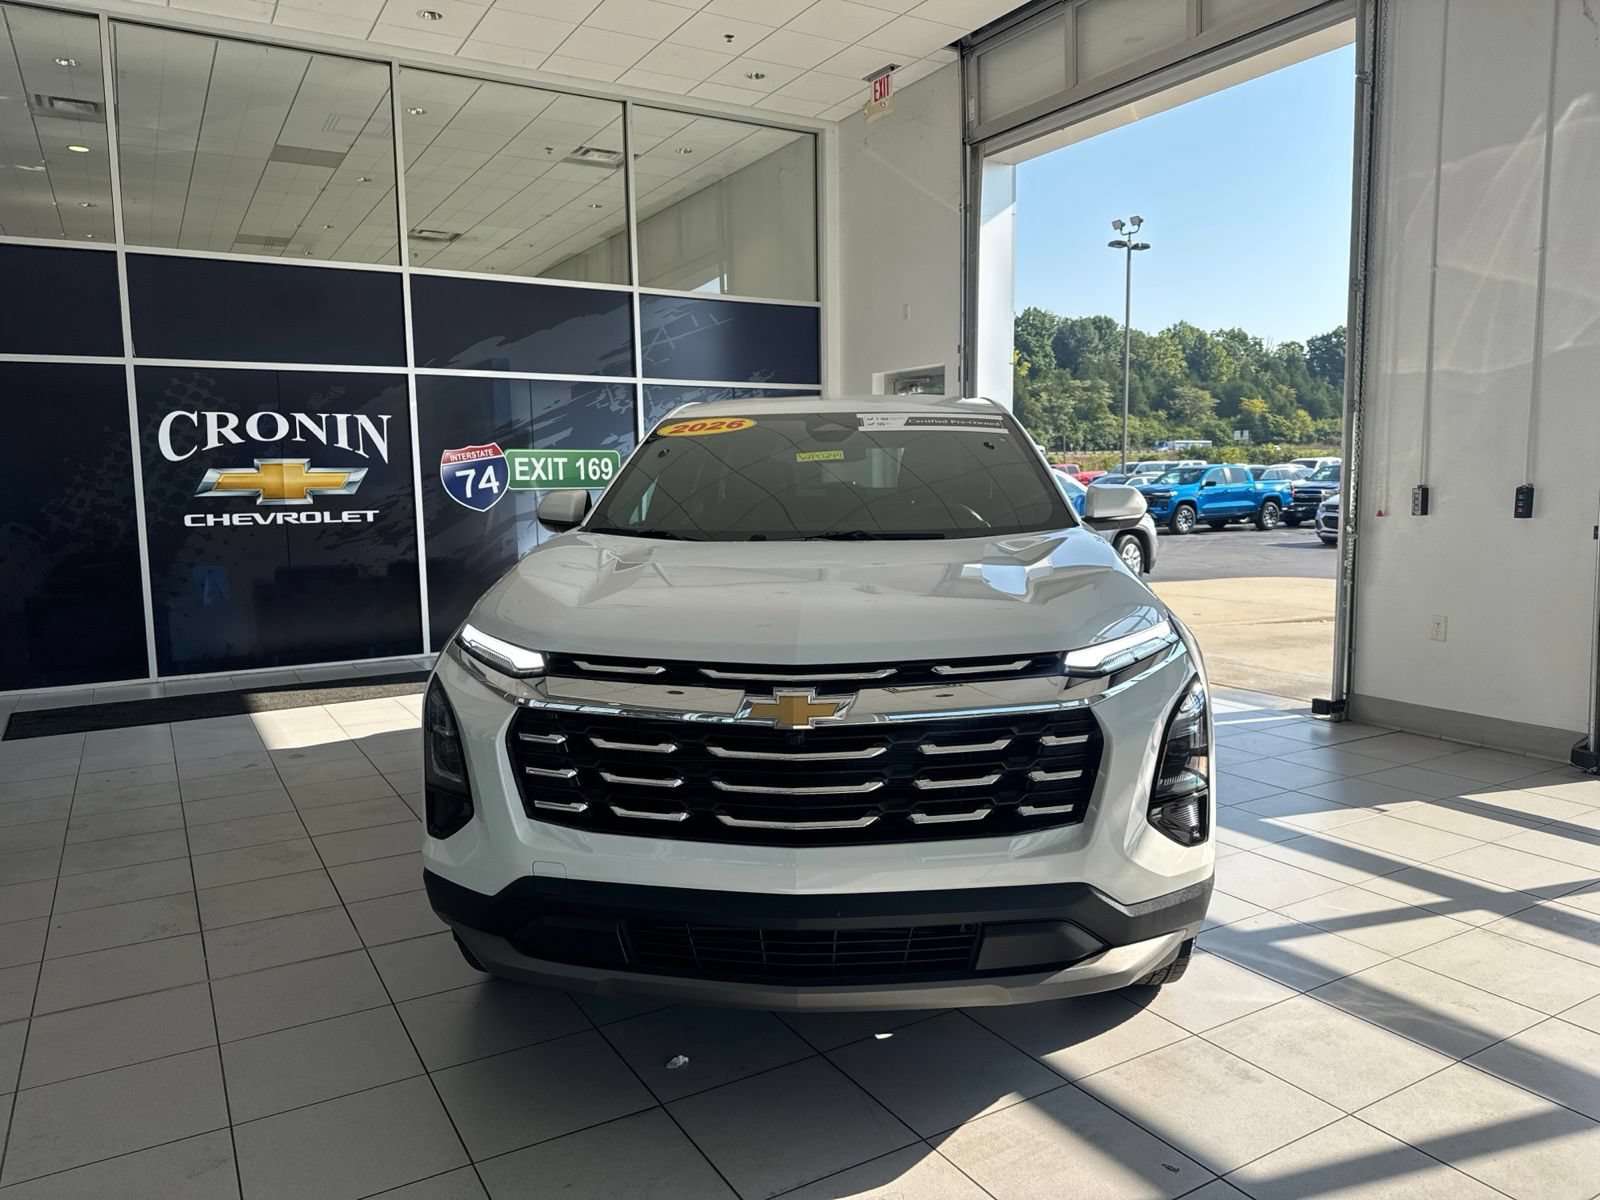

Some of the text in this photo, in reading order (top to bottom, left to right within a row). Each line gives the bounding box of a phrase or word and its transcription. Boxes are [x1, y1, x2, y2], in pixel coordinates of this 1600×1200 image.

[873, 74, 890, 102] EXIT
[667, 420, 746, 435] 2026
[908, 416, 948, 425] Certified
[157, 410, 392, 464] CRONIN
[450, 448, 494, 462] INTERSTATE
[514, 456, 613, 481] EXIT 169
[455, 465, 500, 499] 74
[183, 510, 380, 527] CHEVROLET
